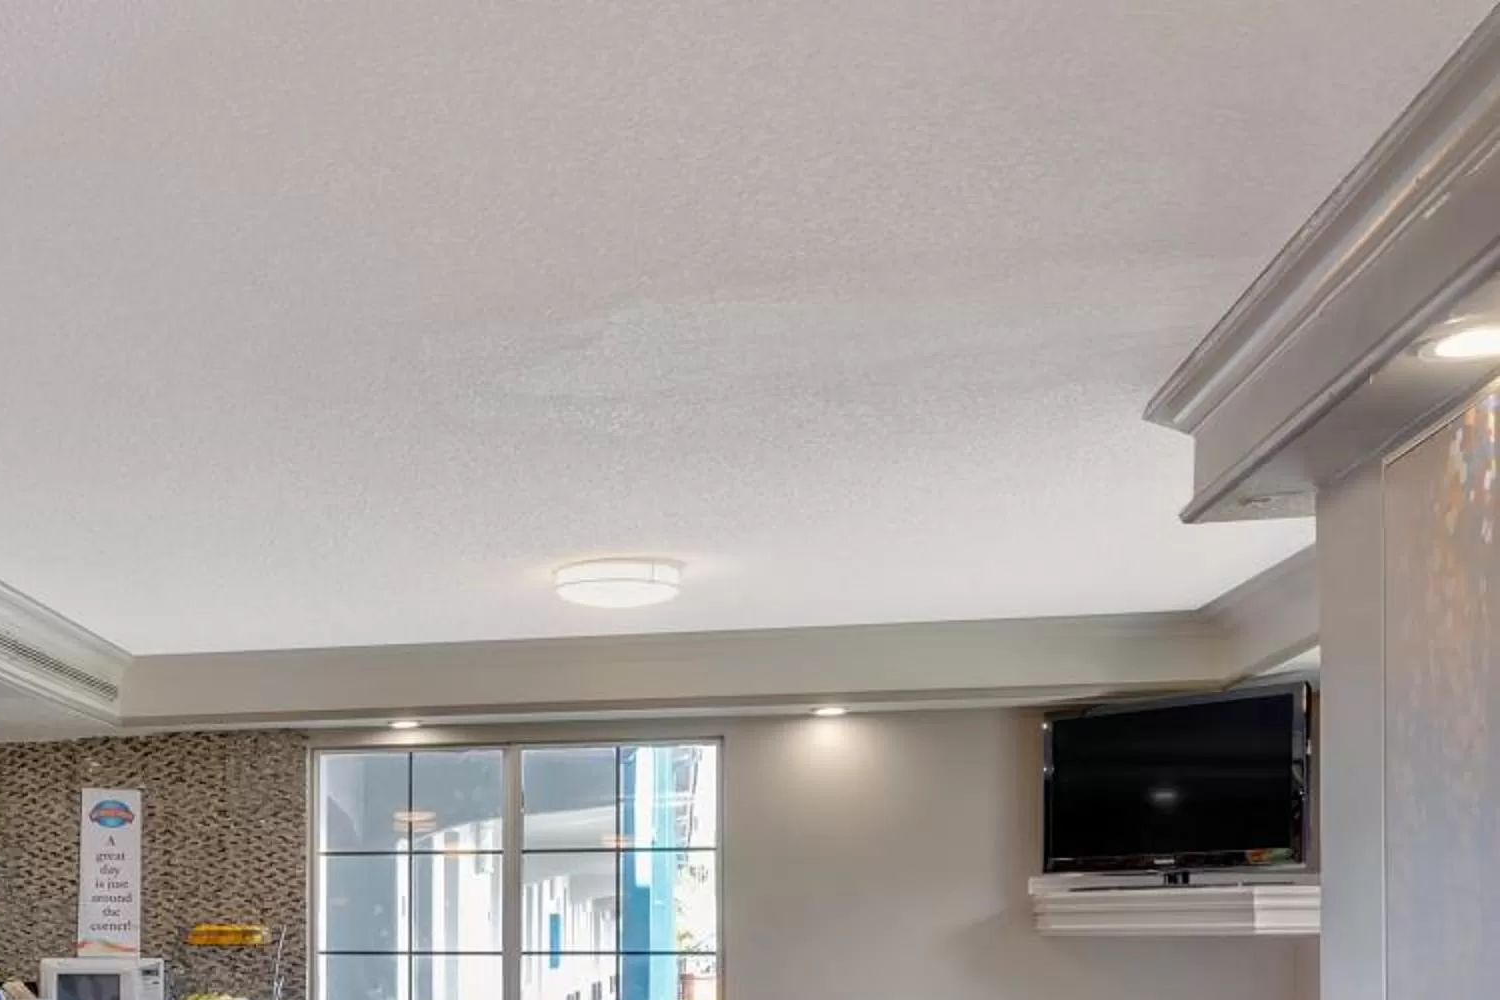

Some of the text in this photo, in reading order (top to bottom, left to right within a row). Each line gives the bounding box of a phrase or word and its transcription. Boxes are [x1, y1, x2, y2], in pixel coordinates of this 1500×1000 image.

[106, 835, 116, 847] A
[95, 852, 126, 864] great
[99, 864, 121, 878] day
[95, 878, 129, 890] is just
[91, 892, 133, 903] around
[101, 906, 121, 917] the
[89, 920, 131, 932] corner!
